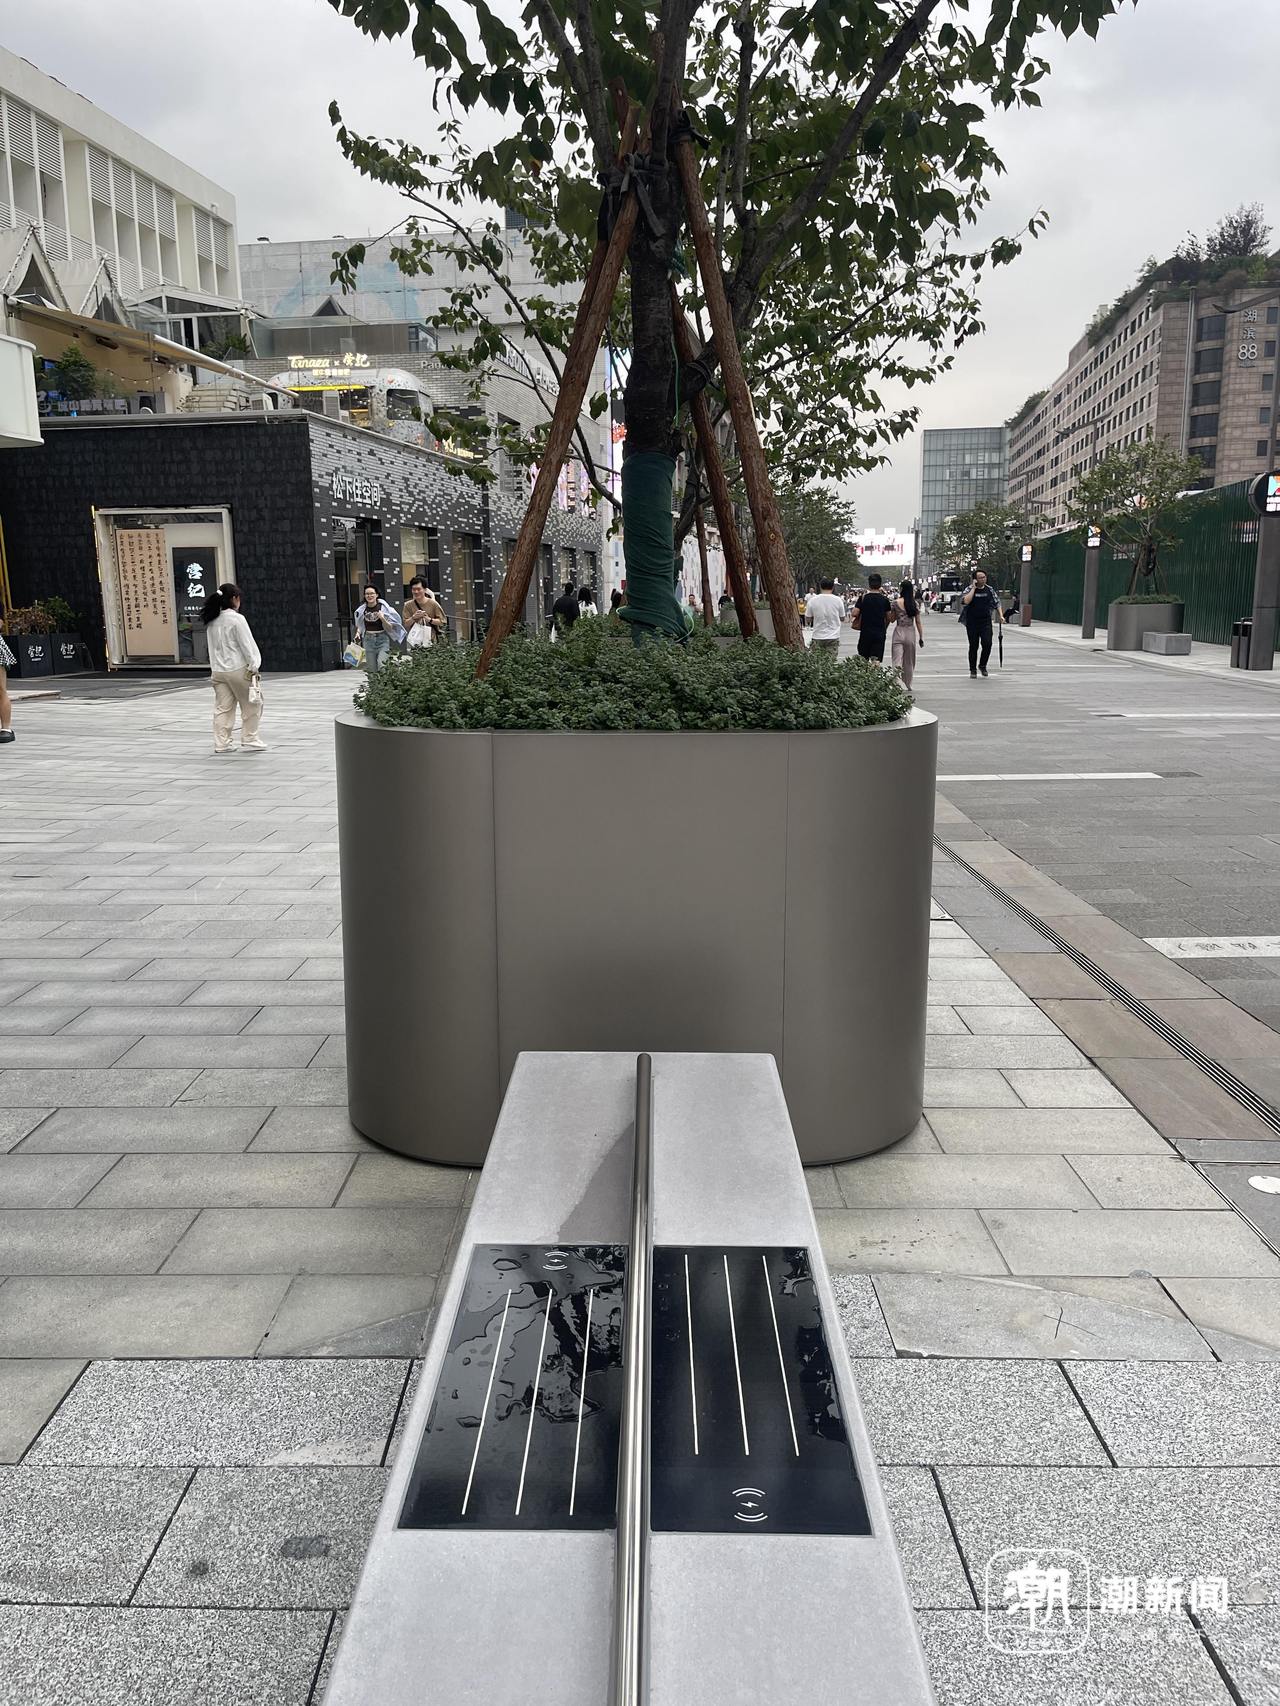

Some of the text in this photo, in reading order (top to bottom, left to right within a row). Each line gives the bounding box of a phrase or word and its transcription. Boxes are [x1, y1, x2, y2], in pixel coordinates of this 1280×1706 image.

[1243, 309, 1258, 340] 湖滨
[1238, 343, 1258, 360] 88
[332, 472, 381, 506] 松下住空间
